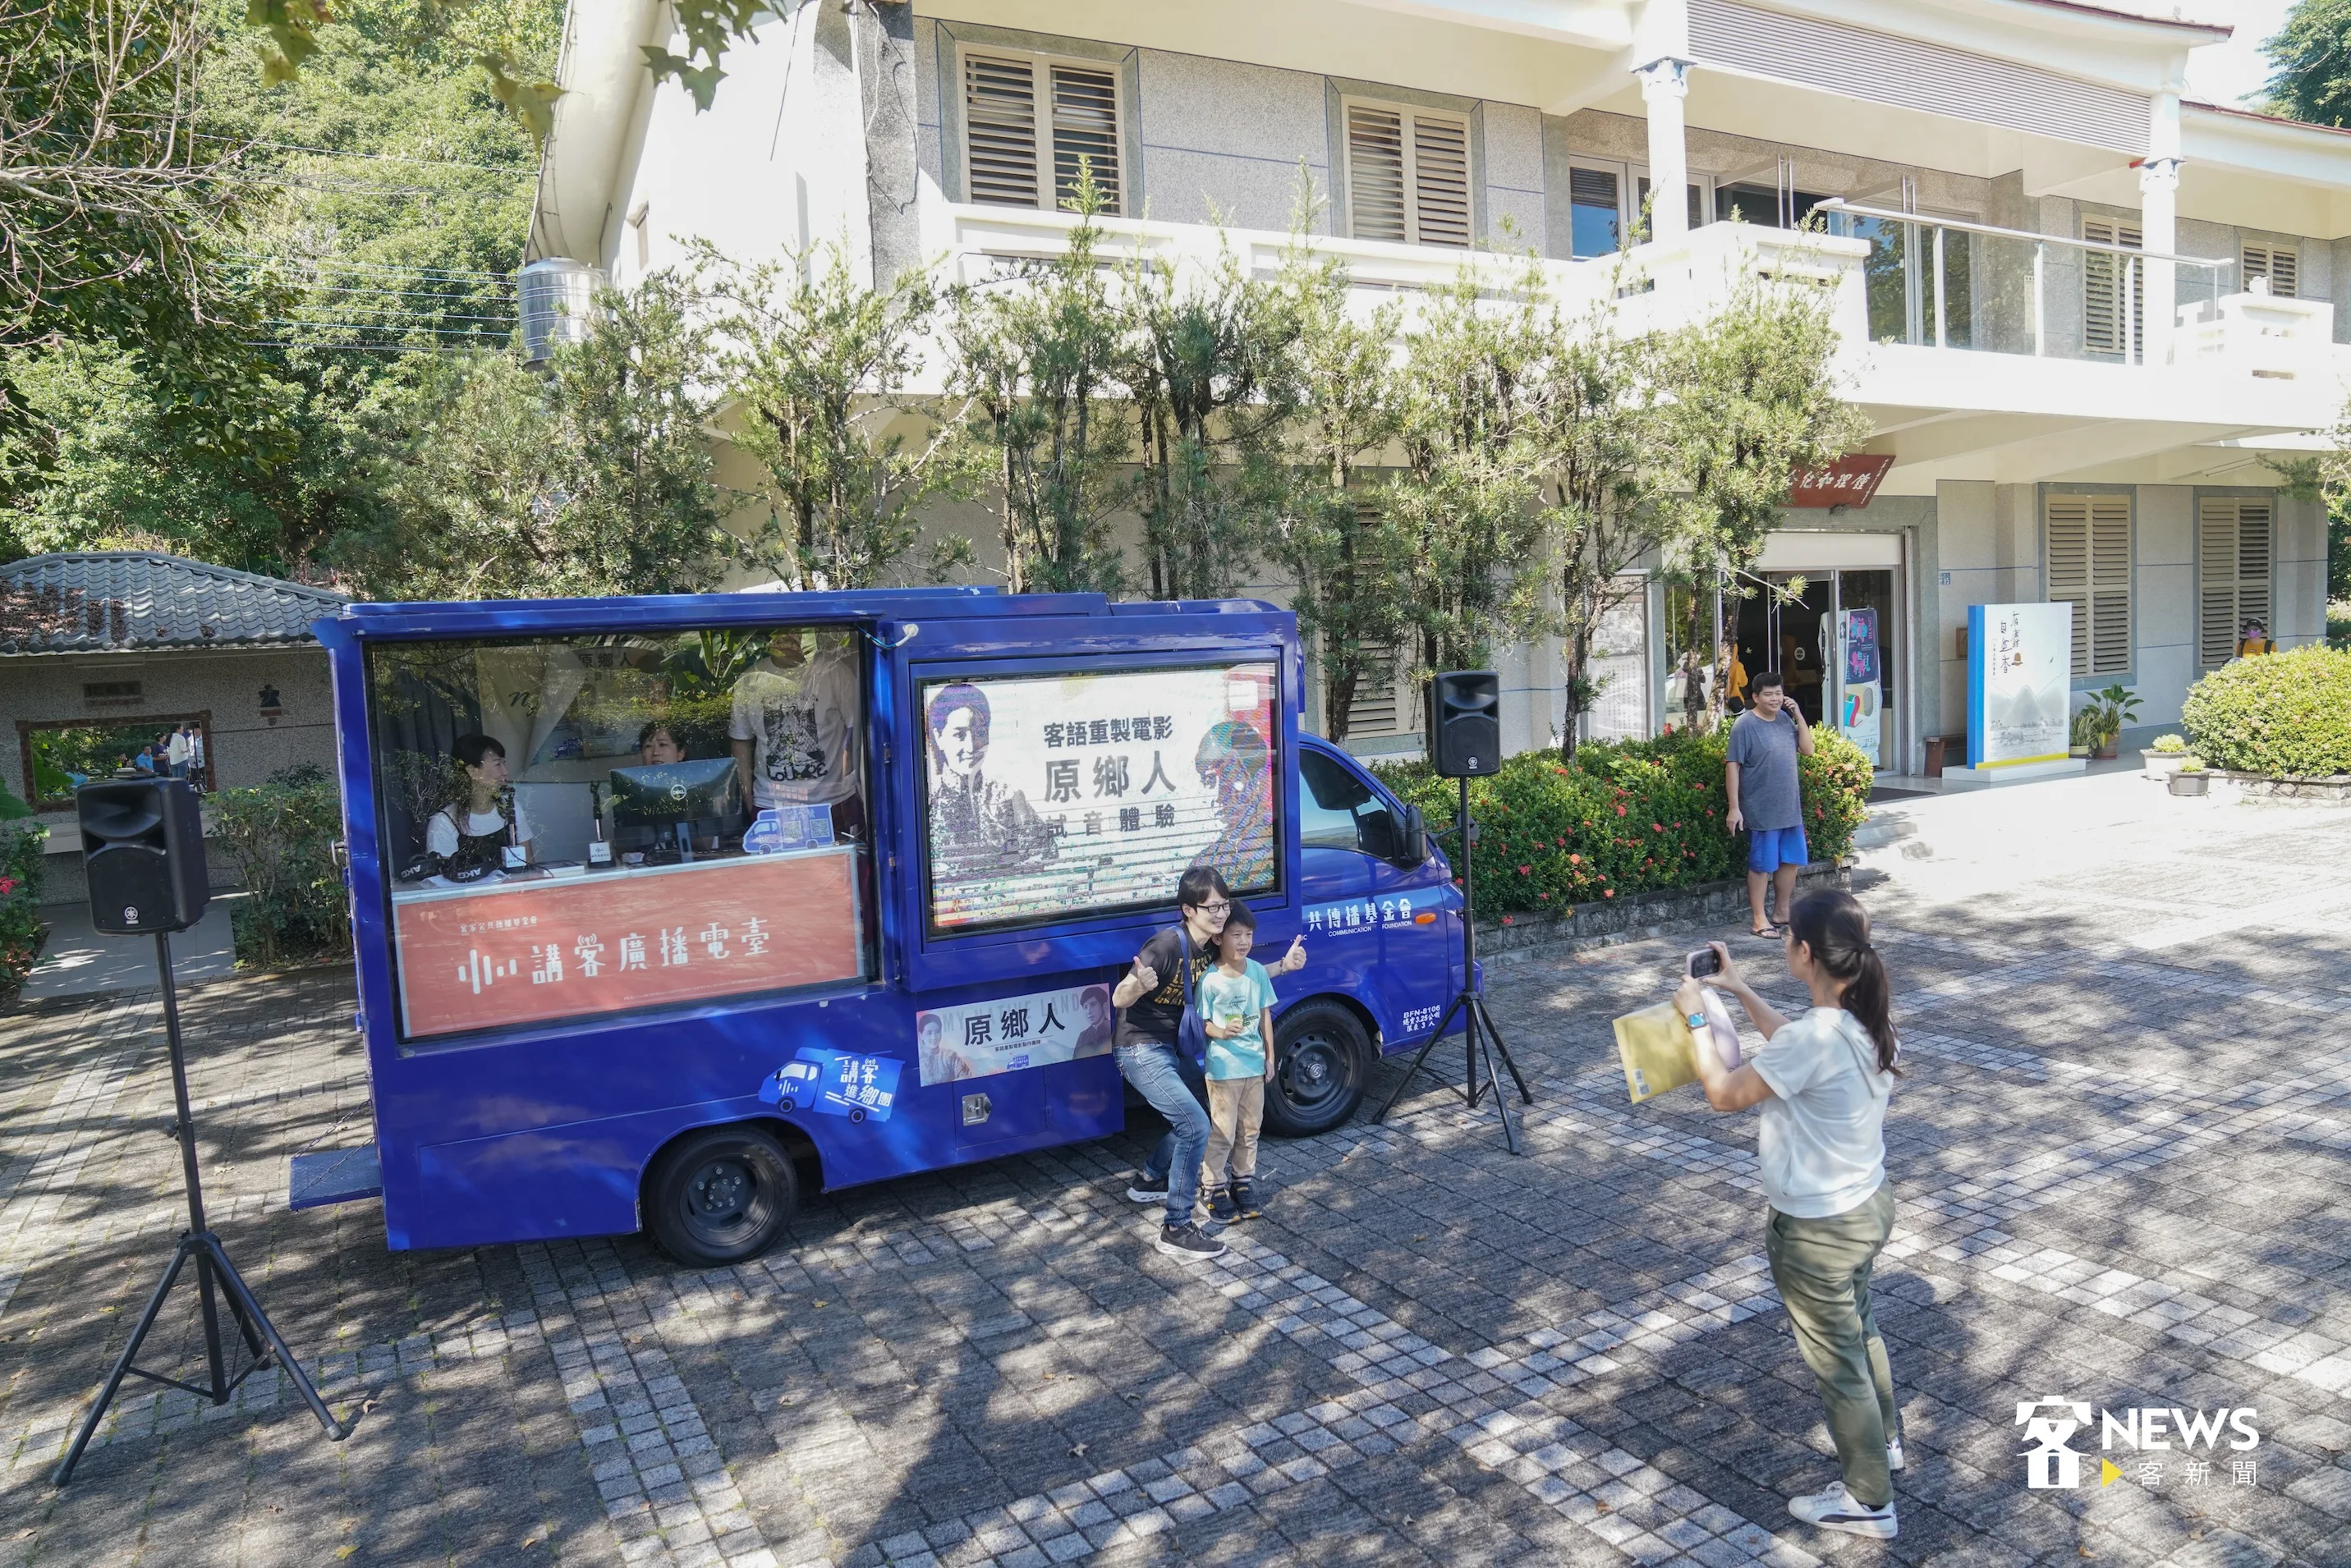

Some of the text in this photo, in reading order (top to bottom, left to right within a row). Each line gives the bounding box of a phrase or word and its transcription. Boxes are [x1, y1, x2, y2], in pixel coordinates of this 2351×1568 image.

[1044, 715, 1173, 748] 客語重製電影
[1044, 750, 1177, 803] 原鄉人
[1045, 804, 1175, 838] 試音體驗
[401, 864, 421, 878] AKG
[457, 867, 481, 878] AKG
[1328, 920, 1412, 938] COMMUNICATION FOUNDATION
[530, 917, 769, 984] 講客廣播電臺
[964, 1002, 1065, 1046] 原鄉人
[1403, 1005, 1440, 1019] BFN-8106
[840, 1058, 879, 1084] 講客
[843, 1084, 893, 1107] 進鄉團
